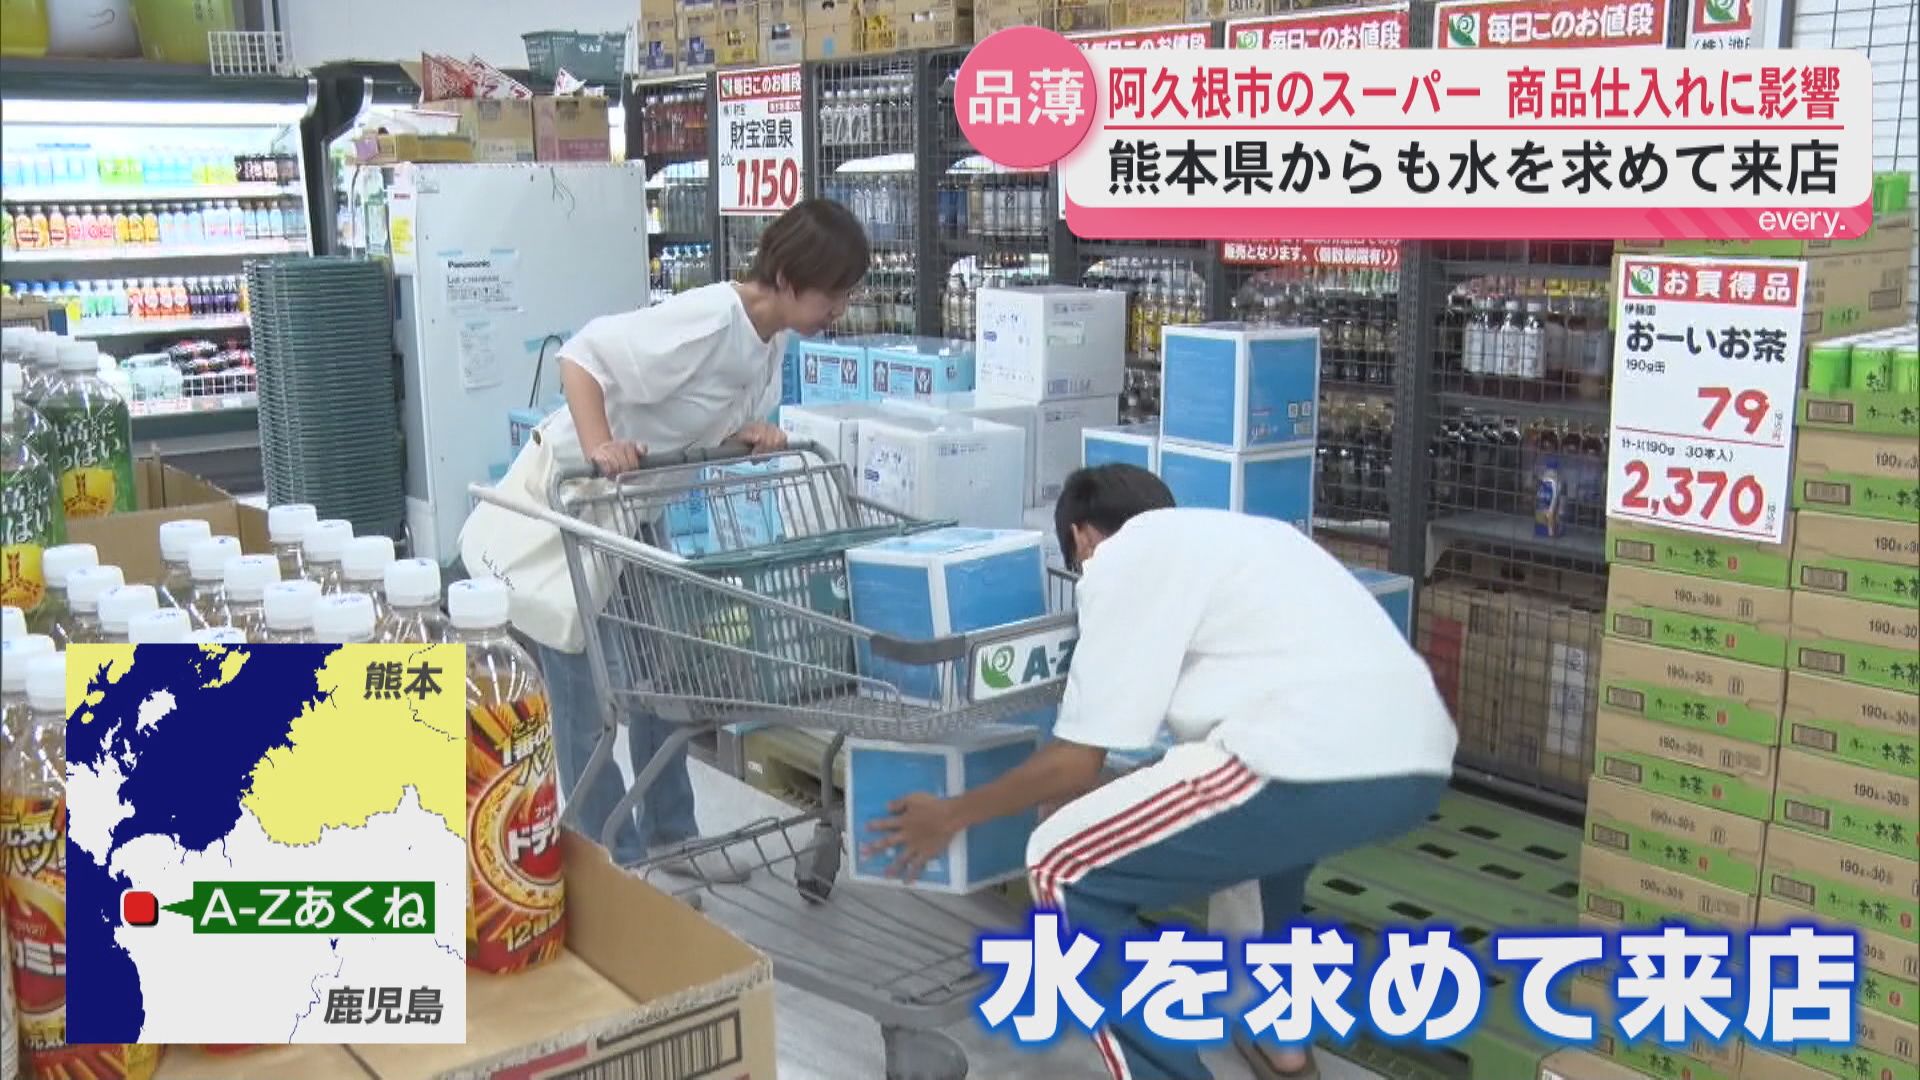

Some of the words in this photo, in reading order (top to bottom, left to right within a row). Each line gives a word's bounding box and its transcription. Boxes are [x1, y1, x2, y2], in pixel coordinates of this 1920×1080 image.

[1487, 3, 1654, 44] 毎日このお値段
[730, 118, 793, 150] 財宝温泉
[1664, 270, 1791, 301] お買得品
[1626, 320, 1788, 364] おーいお茶
[1697, 387, 1770, 434] 79
[1621, 459, 1763, 526] 2,370
